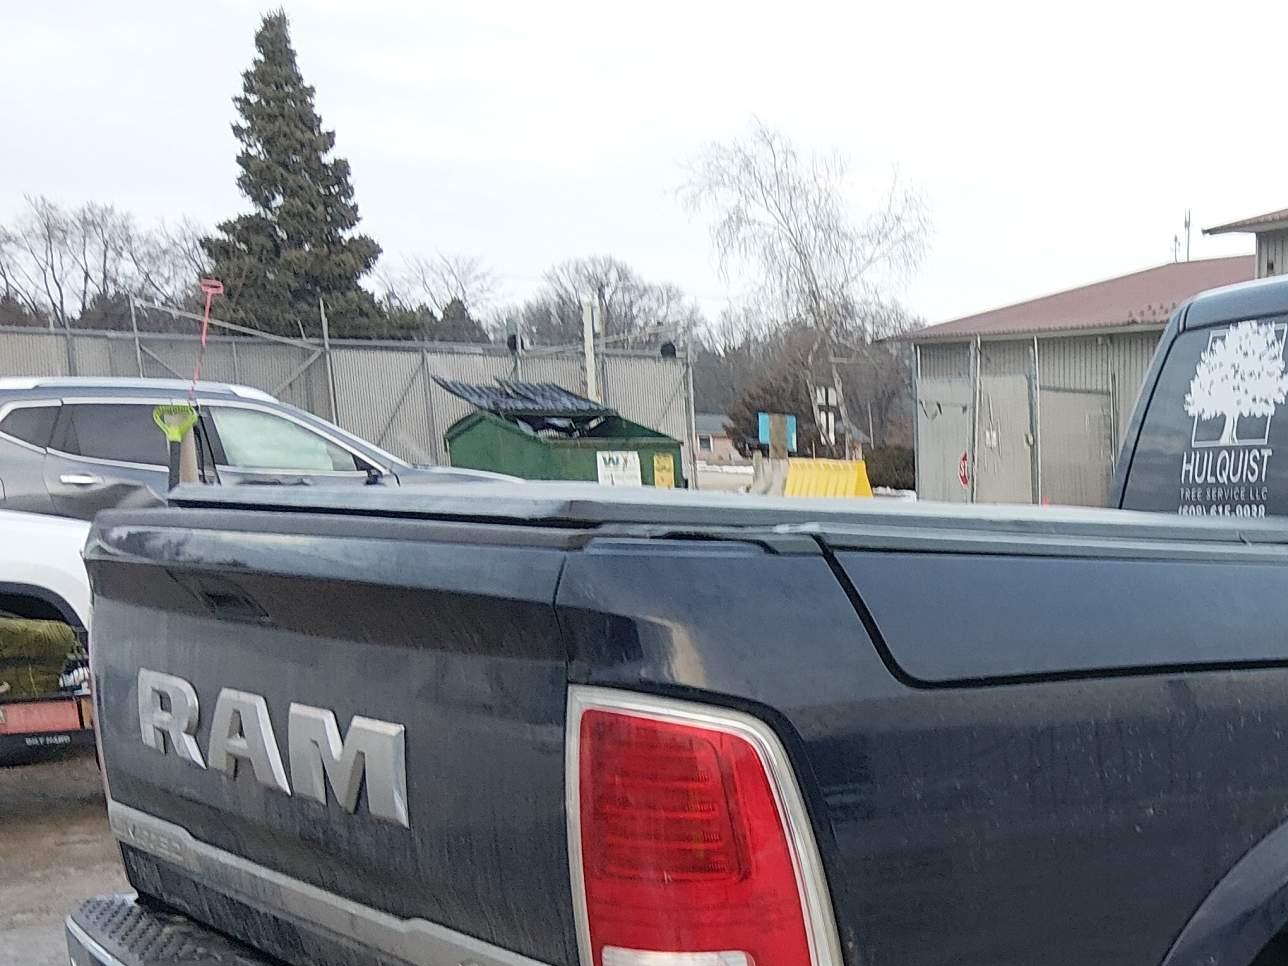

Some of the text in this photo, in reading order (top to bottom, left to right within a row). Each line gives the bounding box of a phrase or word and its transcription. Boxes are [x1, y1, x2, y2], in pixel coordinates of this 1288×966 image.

[1181, 449, 1272, 484] HULQUIST
[1180, 486, 1268, 501] TREE SERVICE LLC
[138, 667, 410, 829] RAM
